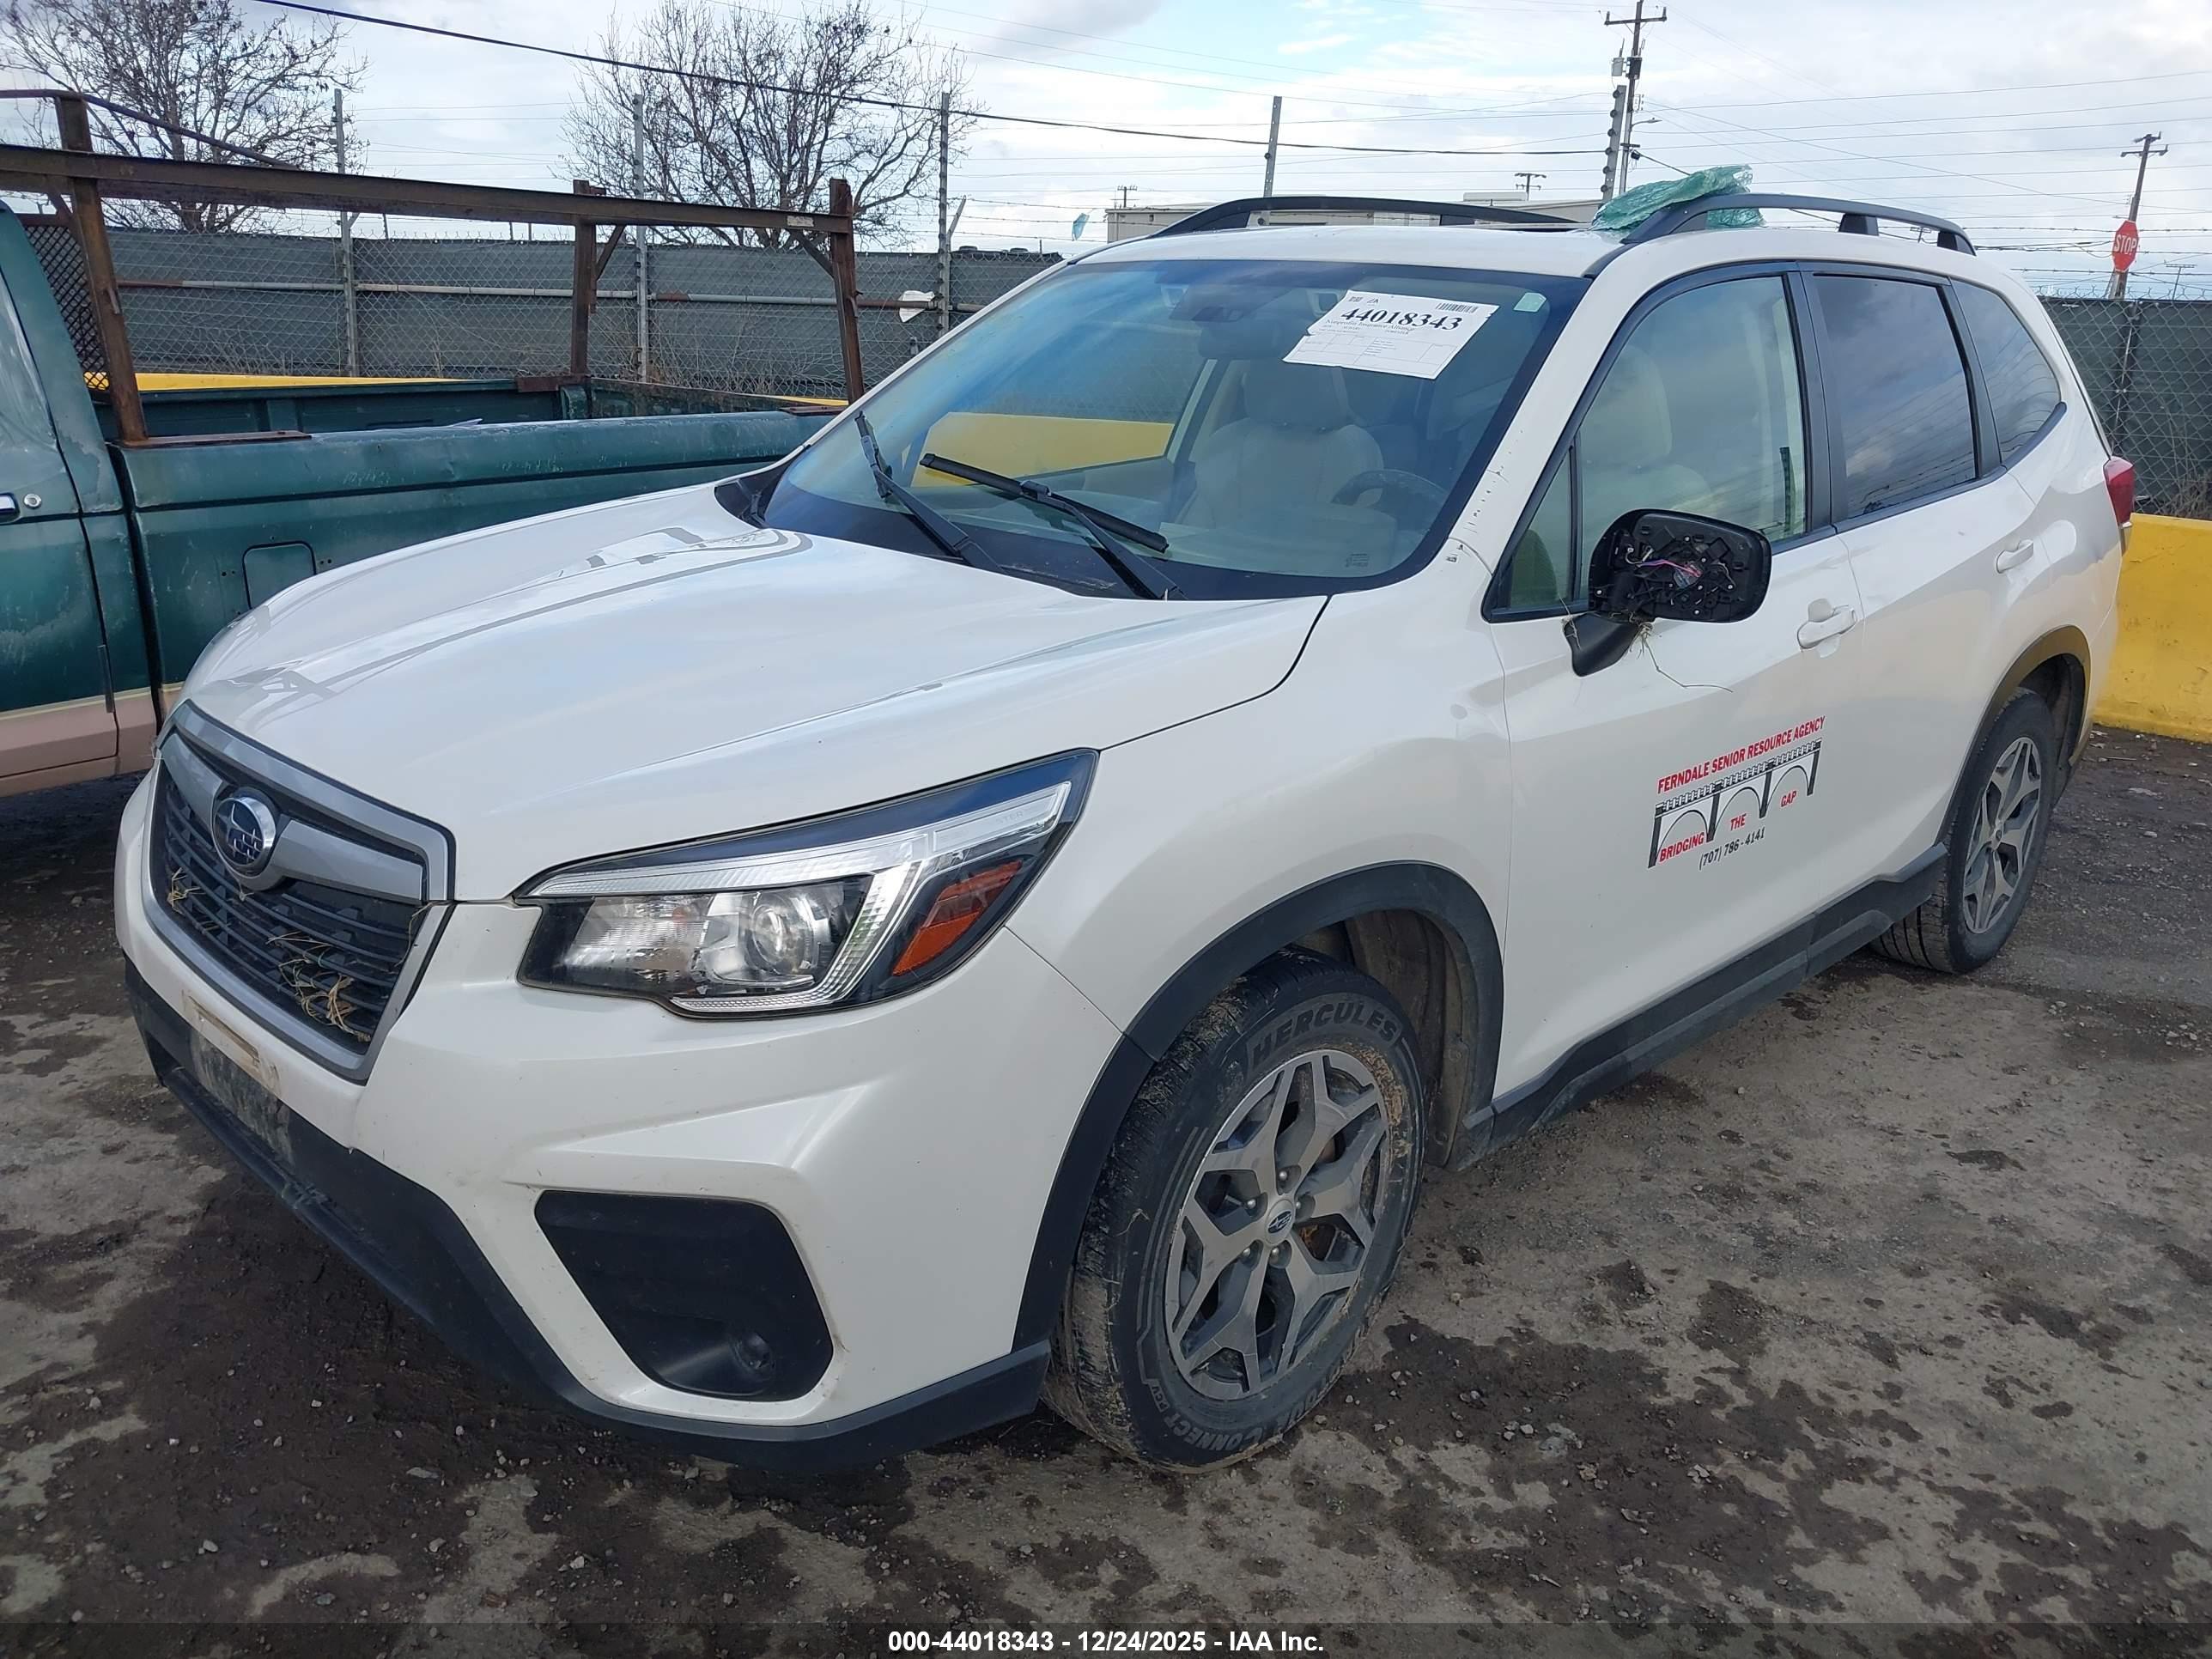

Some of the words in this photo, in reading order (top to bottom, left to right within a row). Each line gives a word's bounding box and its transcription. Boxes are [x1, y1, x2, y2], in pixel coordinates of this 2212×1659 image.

[2113, 234, 2136, 255] STOP
[1340, 307, 1463, 331] 44018343
[1657, 761, 1710, 794] FERNDALE
[1711, 749, 1746, 773] SENIOR
[1747, 729, 1793, 758] RESOURCE
[1793, 715, 1826, 740] AGENCY
[1659, 832, 1705, 863] BRIDGING
[1730, 813, 1747, 830] THE
[1780, 790, 1797, 807] GAP
[1698, 845, 1723, 871] (707)
[1253, 1001, 1397, 1066] HERCULES
